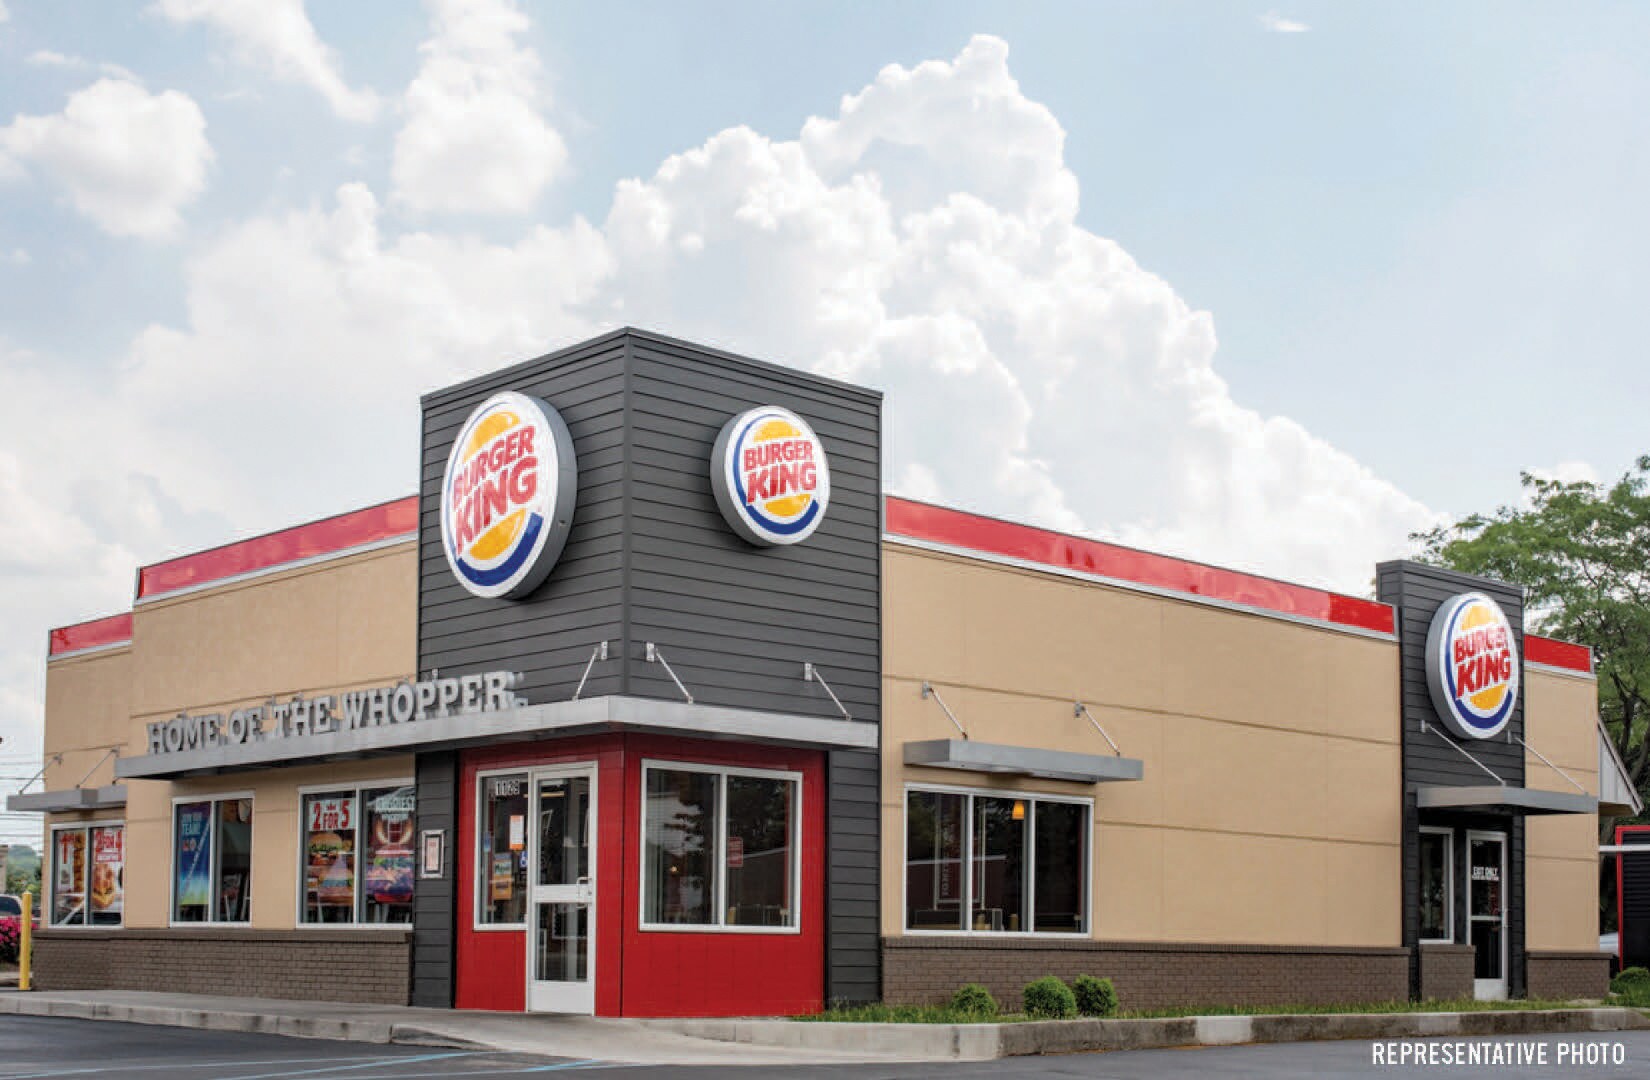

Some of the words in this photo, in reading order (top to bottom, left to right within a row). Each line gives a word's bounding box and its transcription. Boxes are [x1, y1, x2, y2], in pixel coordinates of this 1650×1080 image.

[453, 425, 536, 510] BURGER
[743, 441, 813, 472] BURGER
[747, 462, 817, 503] KING
[455, 456, 538, 555] KING
[1454, 627, 1507, 664] BURGER
[1457, 649, 1511, 697] KING
[147, 713, 221, 755] HOME
[228, 705, 265, 747] OF
[273, 696, 333, 739] THE
[341, 671, 514, 730] WHOPPER
[313, 803, 323, 830] 2
[323, 811, 339, 829] FOR
[341, 800, 350, 828] 5
